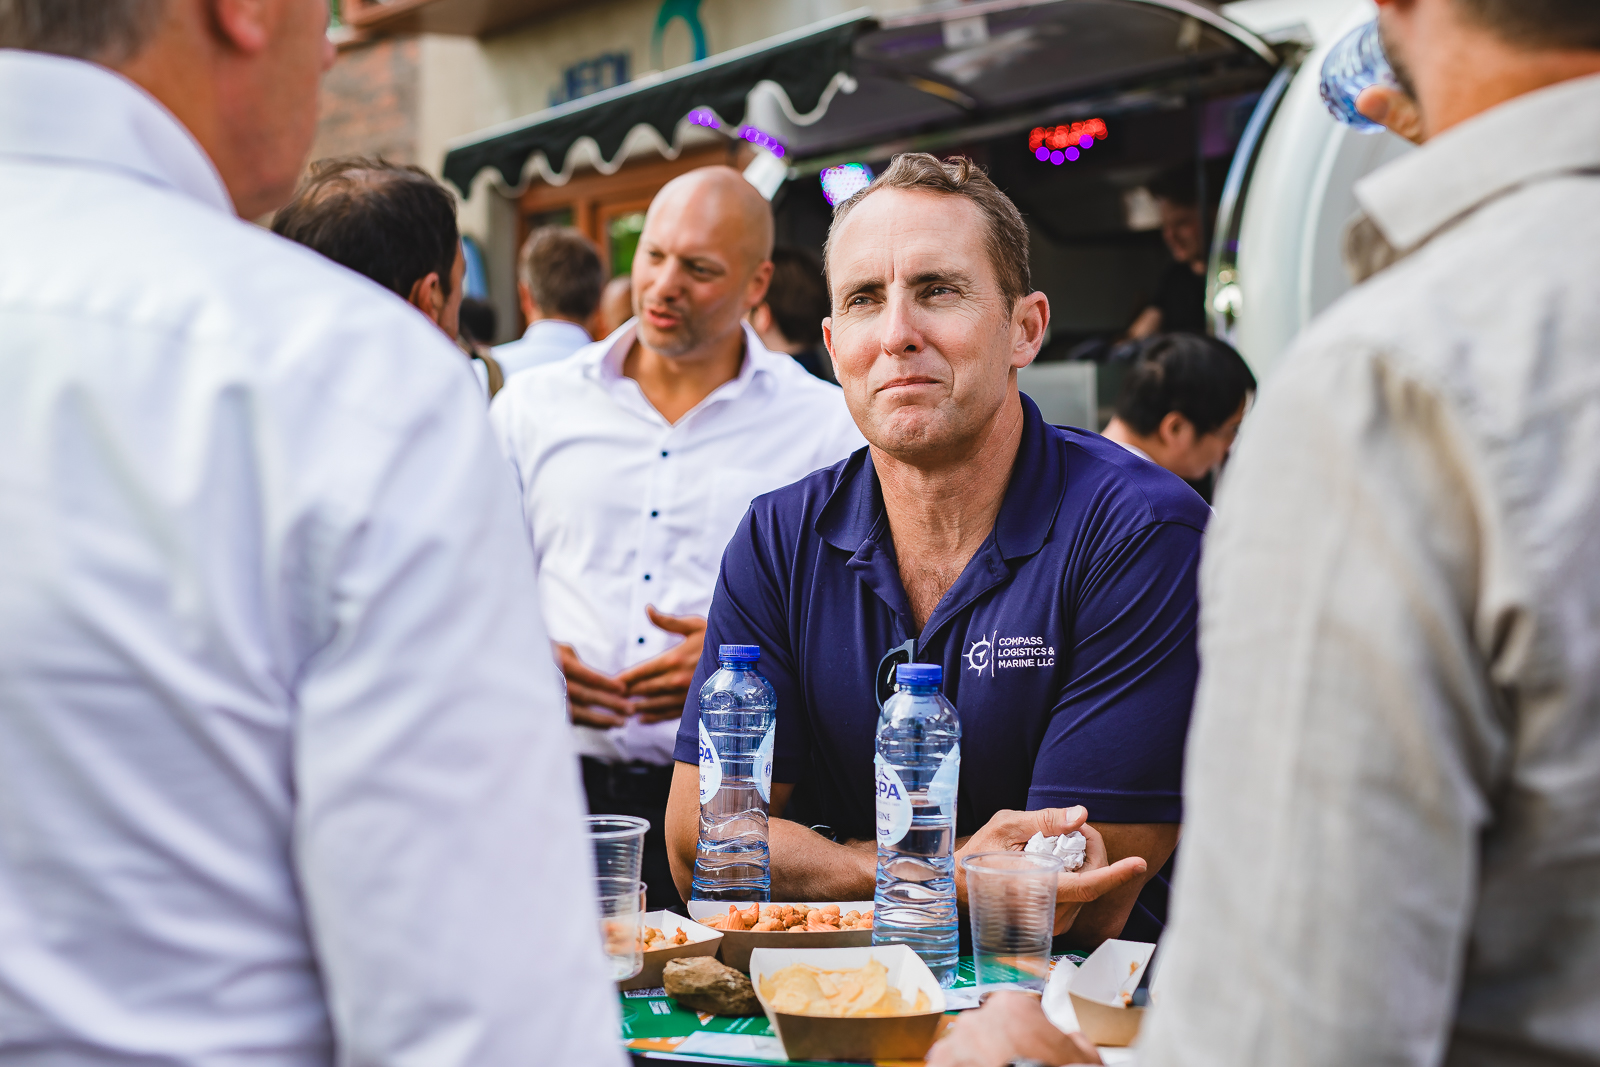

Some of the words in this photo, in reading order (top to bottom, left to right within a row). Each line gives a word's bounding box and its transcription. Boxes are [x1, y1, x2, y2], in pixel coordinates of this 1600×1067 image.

[998, 636, 1043, 646] COMPASS
[997, 647, 1047, 657] LOGISTICS
[1047, 646, 1055, 656] &
[998, 658, 1035, 668] MARINE
[1037, 658, 1055, 667] LLC
